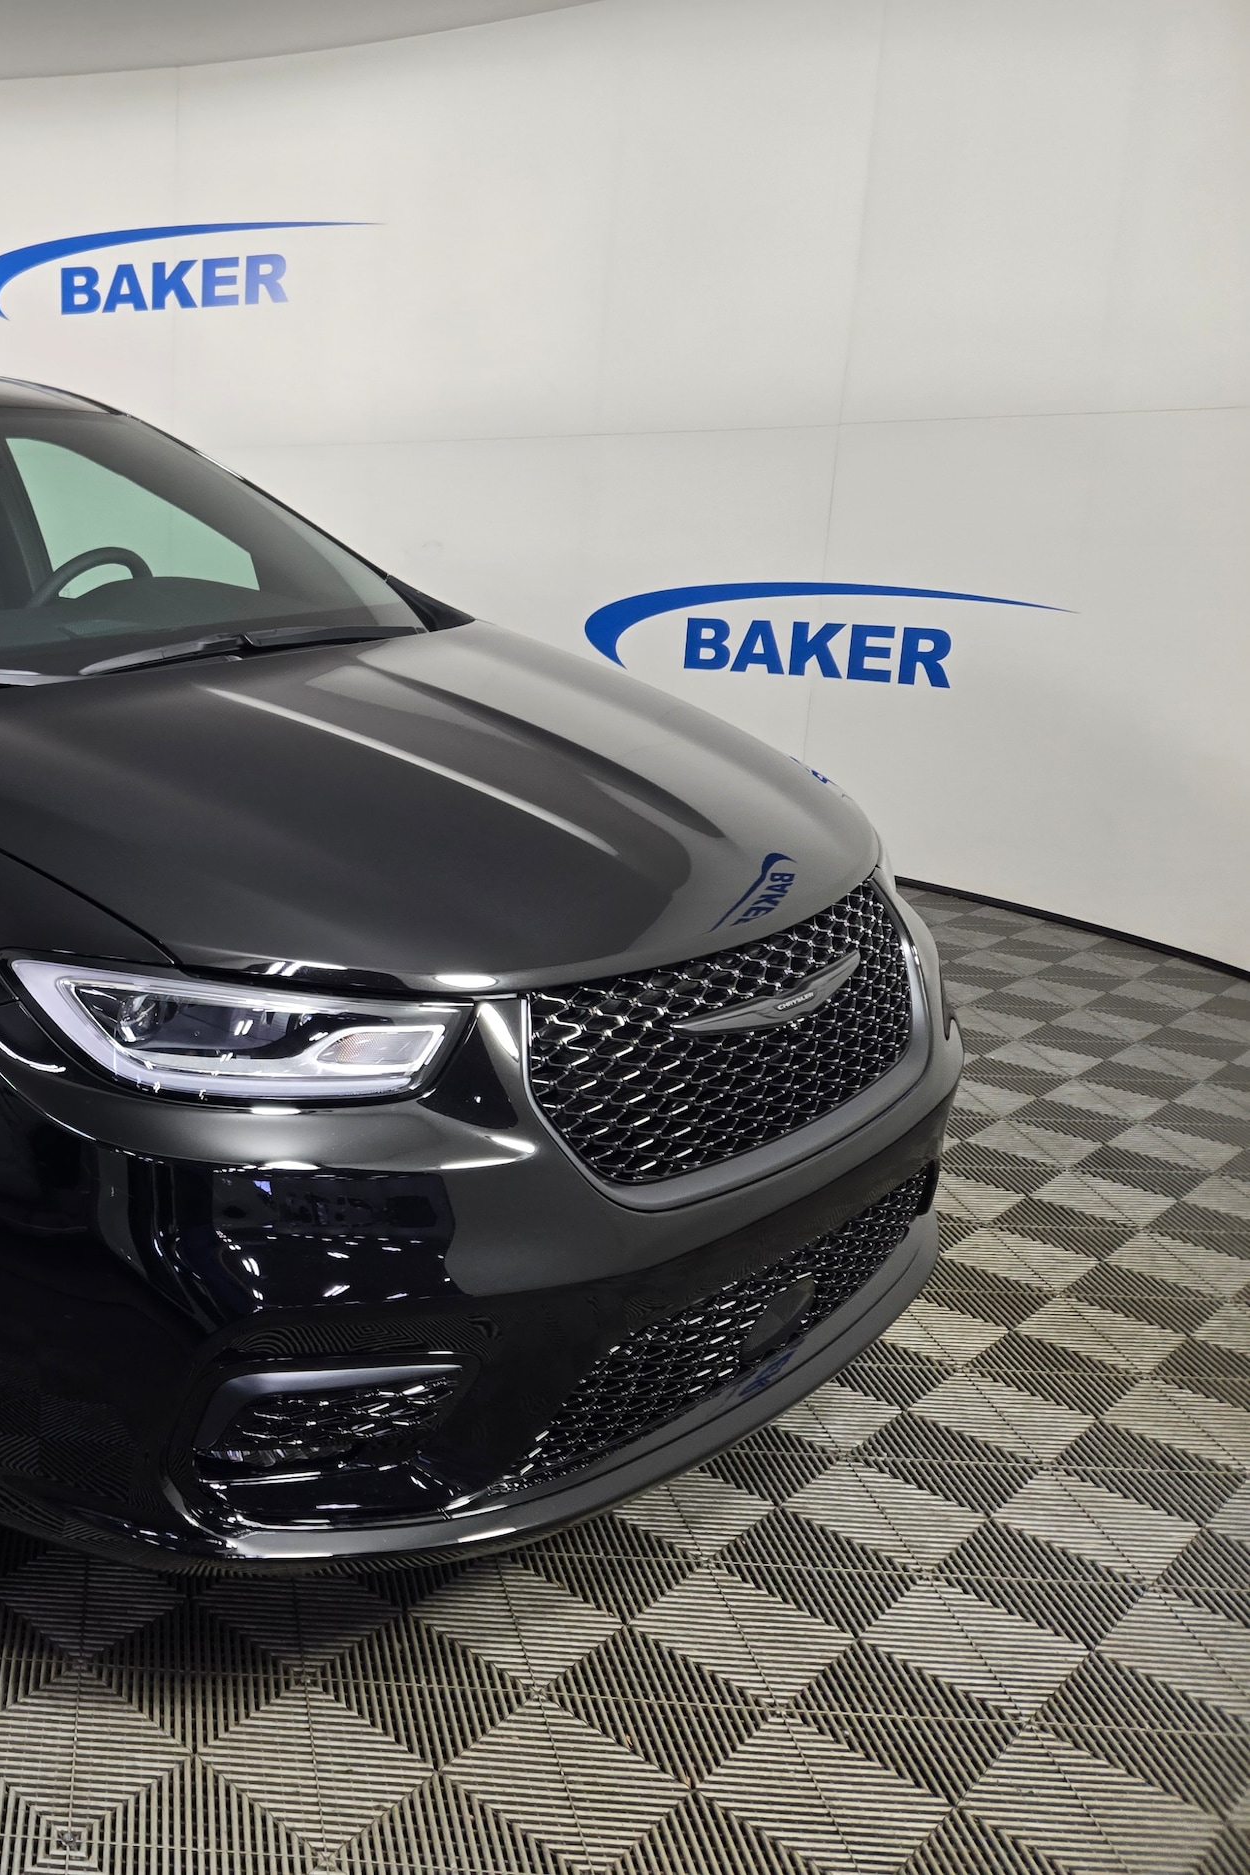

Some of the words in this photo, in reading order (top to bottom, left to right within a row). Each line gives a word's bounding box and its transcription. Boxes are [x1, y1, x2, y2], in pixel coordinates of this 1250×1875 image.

[61, 253, 289, 315] BAKER
[684, 617, 951, 688] BAKER
[777, 992, 814, 1010] CHRYSLER
